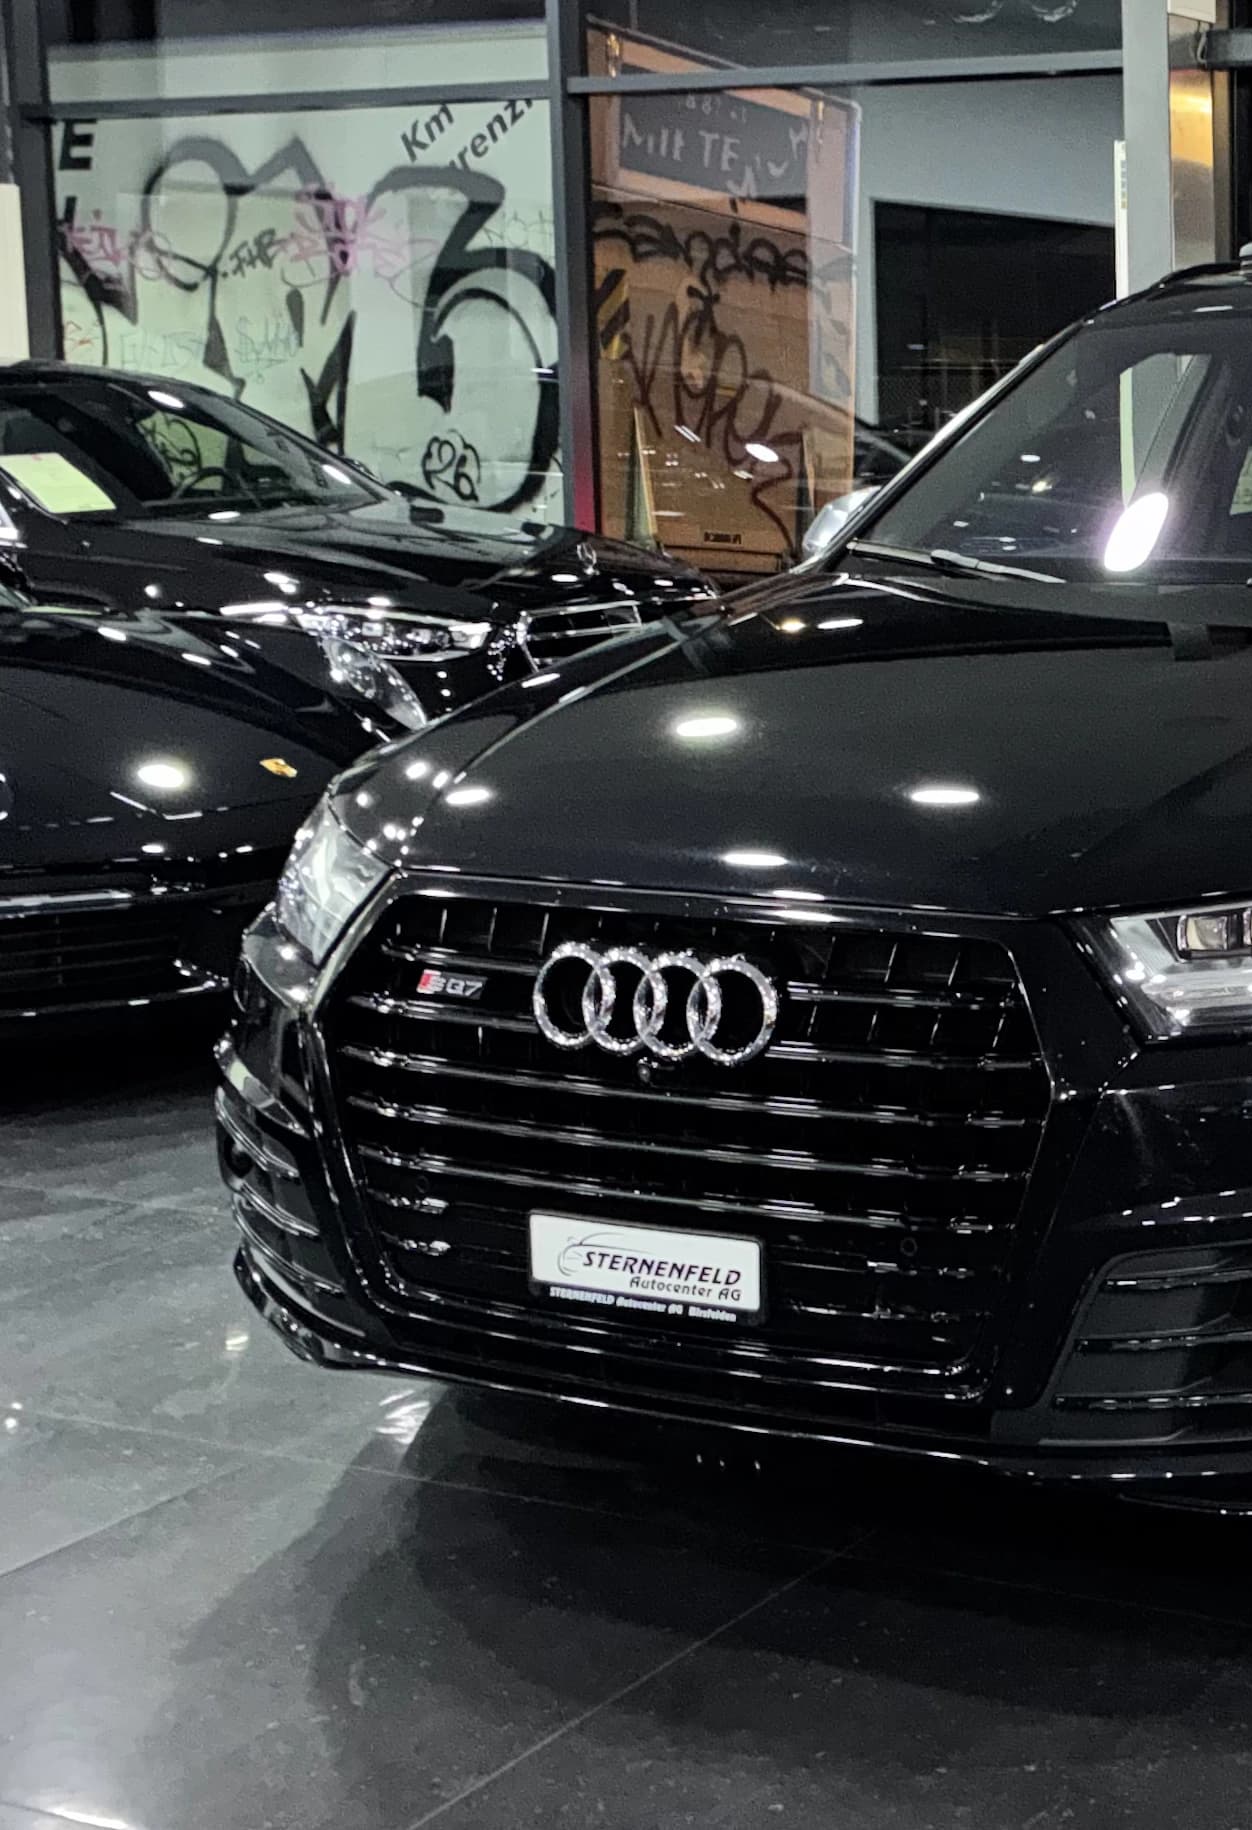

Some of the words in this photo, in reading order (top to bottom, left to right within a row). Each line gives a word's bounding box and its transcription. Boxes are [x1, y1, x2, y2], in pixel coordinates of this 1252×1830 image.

[401, 104, 454, 162] Km
[449, 100, 533, 172] renz
[416, 969, 483, 996] SQ7
[583, 1251, 741, 1286] STERNENFELD
[629, 1276, 712, 1298] Autocenter
[718, 1287, 741, 1301] AG
